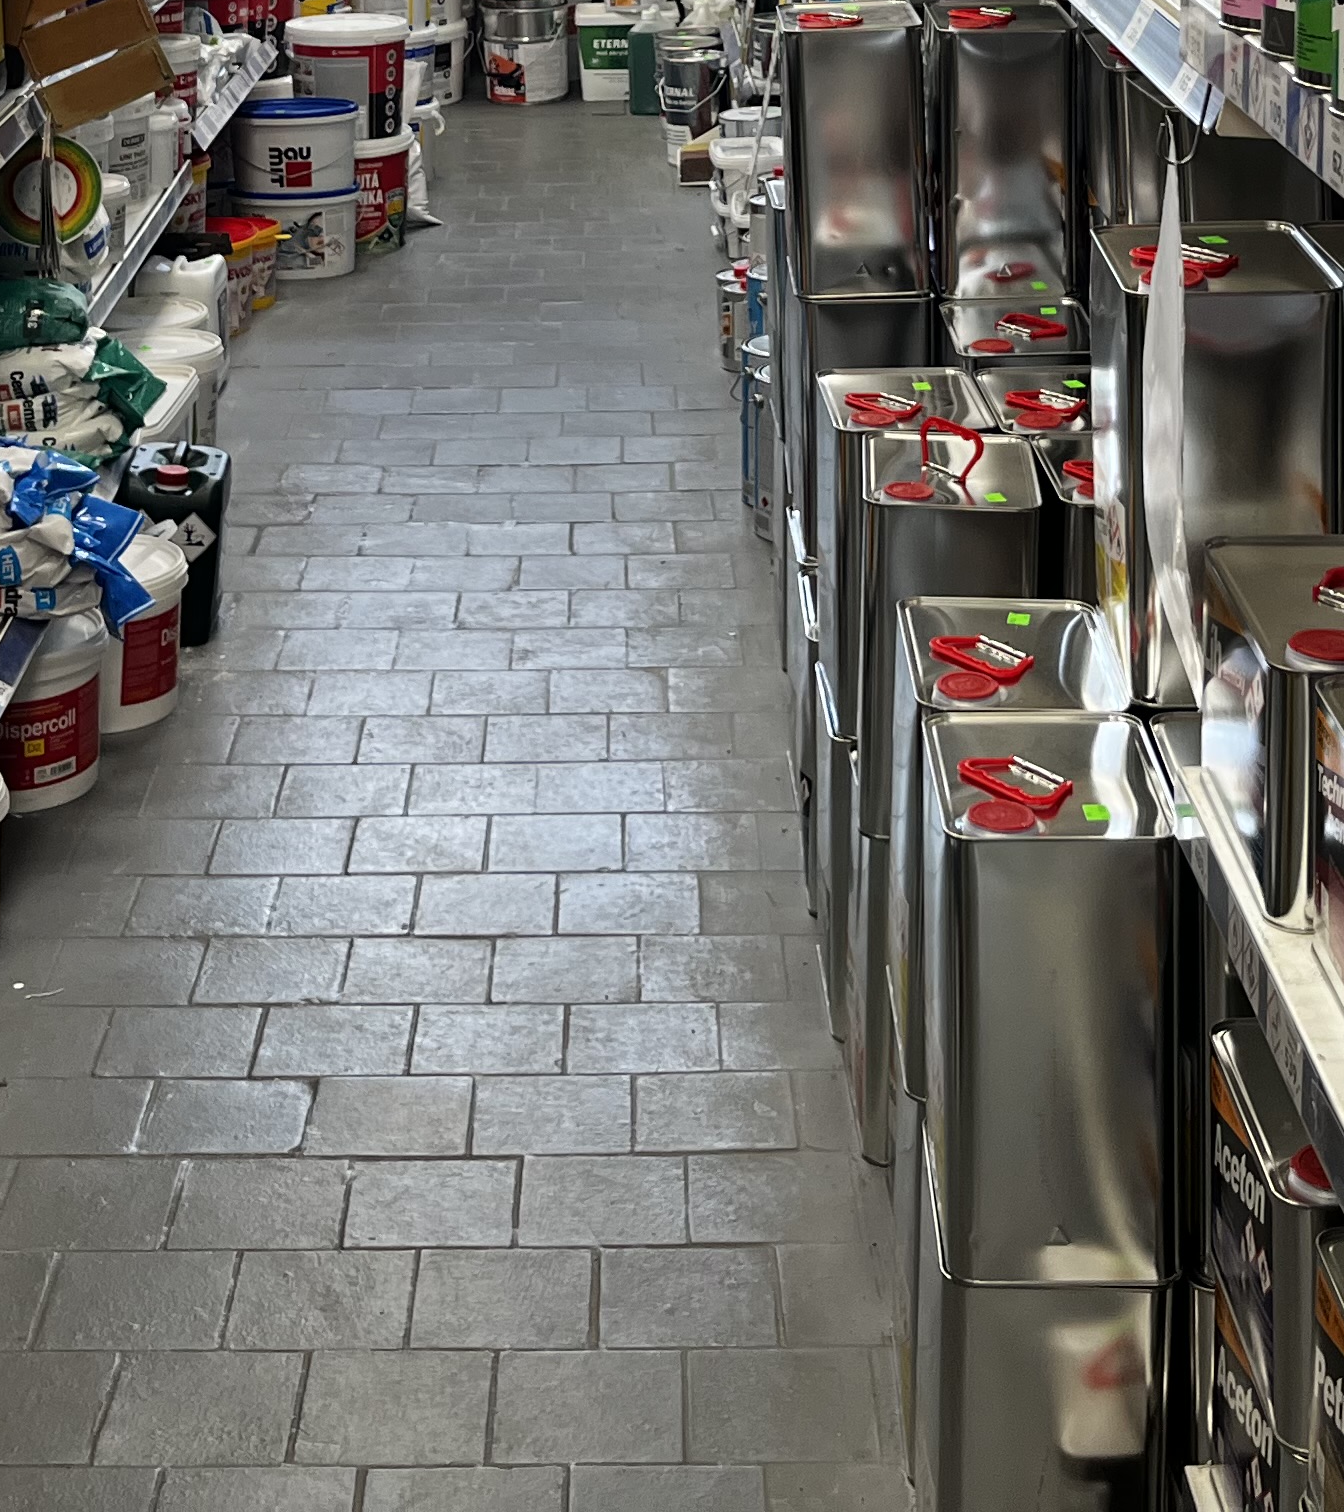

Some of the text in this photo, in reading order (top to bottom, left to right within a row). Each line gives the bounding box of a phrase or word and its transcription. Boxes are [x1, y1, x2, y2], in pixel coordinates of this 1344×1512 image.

[1, 554, 14, 585] HET
[1213, 1121, 1266, 1223] Aceton
[1217, 1340, 1275, 1468] Aceton
